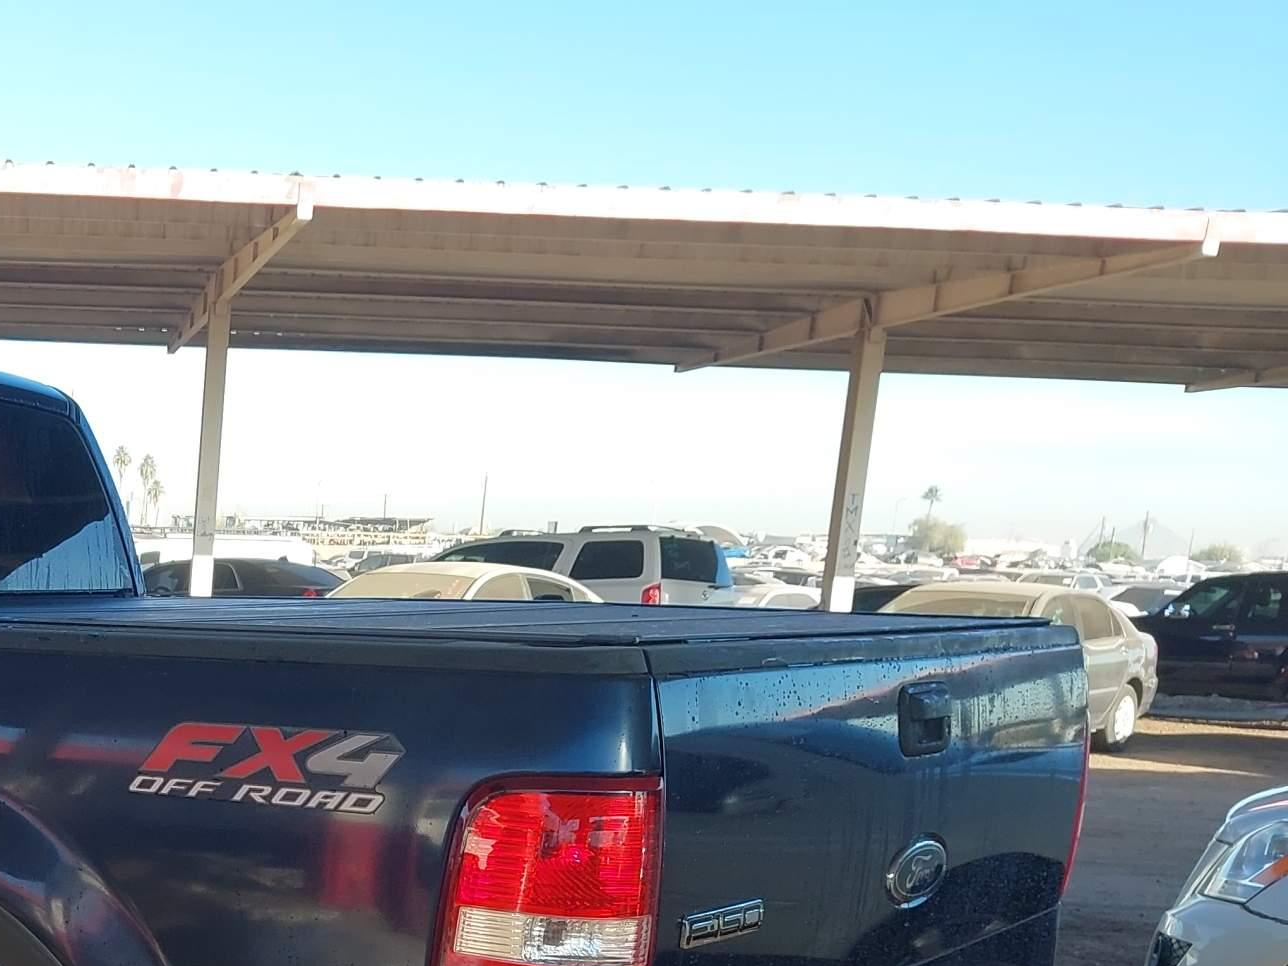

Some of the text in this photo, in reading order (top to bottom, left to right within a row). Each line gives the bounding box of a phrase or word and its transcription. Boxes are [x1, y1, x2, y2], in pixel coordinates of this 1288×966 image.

[138, 722, 406, 789] FX4
[128, 775, 385, 814] OFF ROAD
